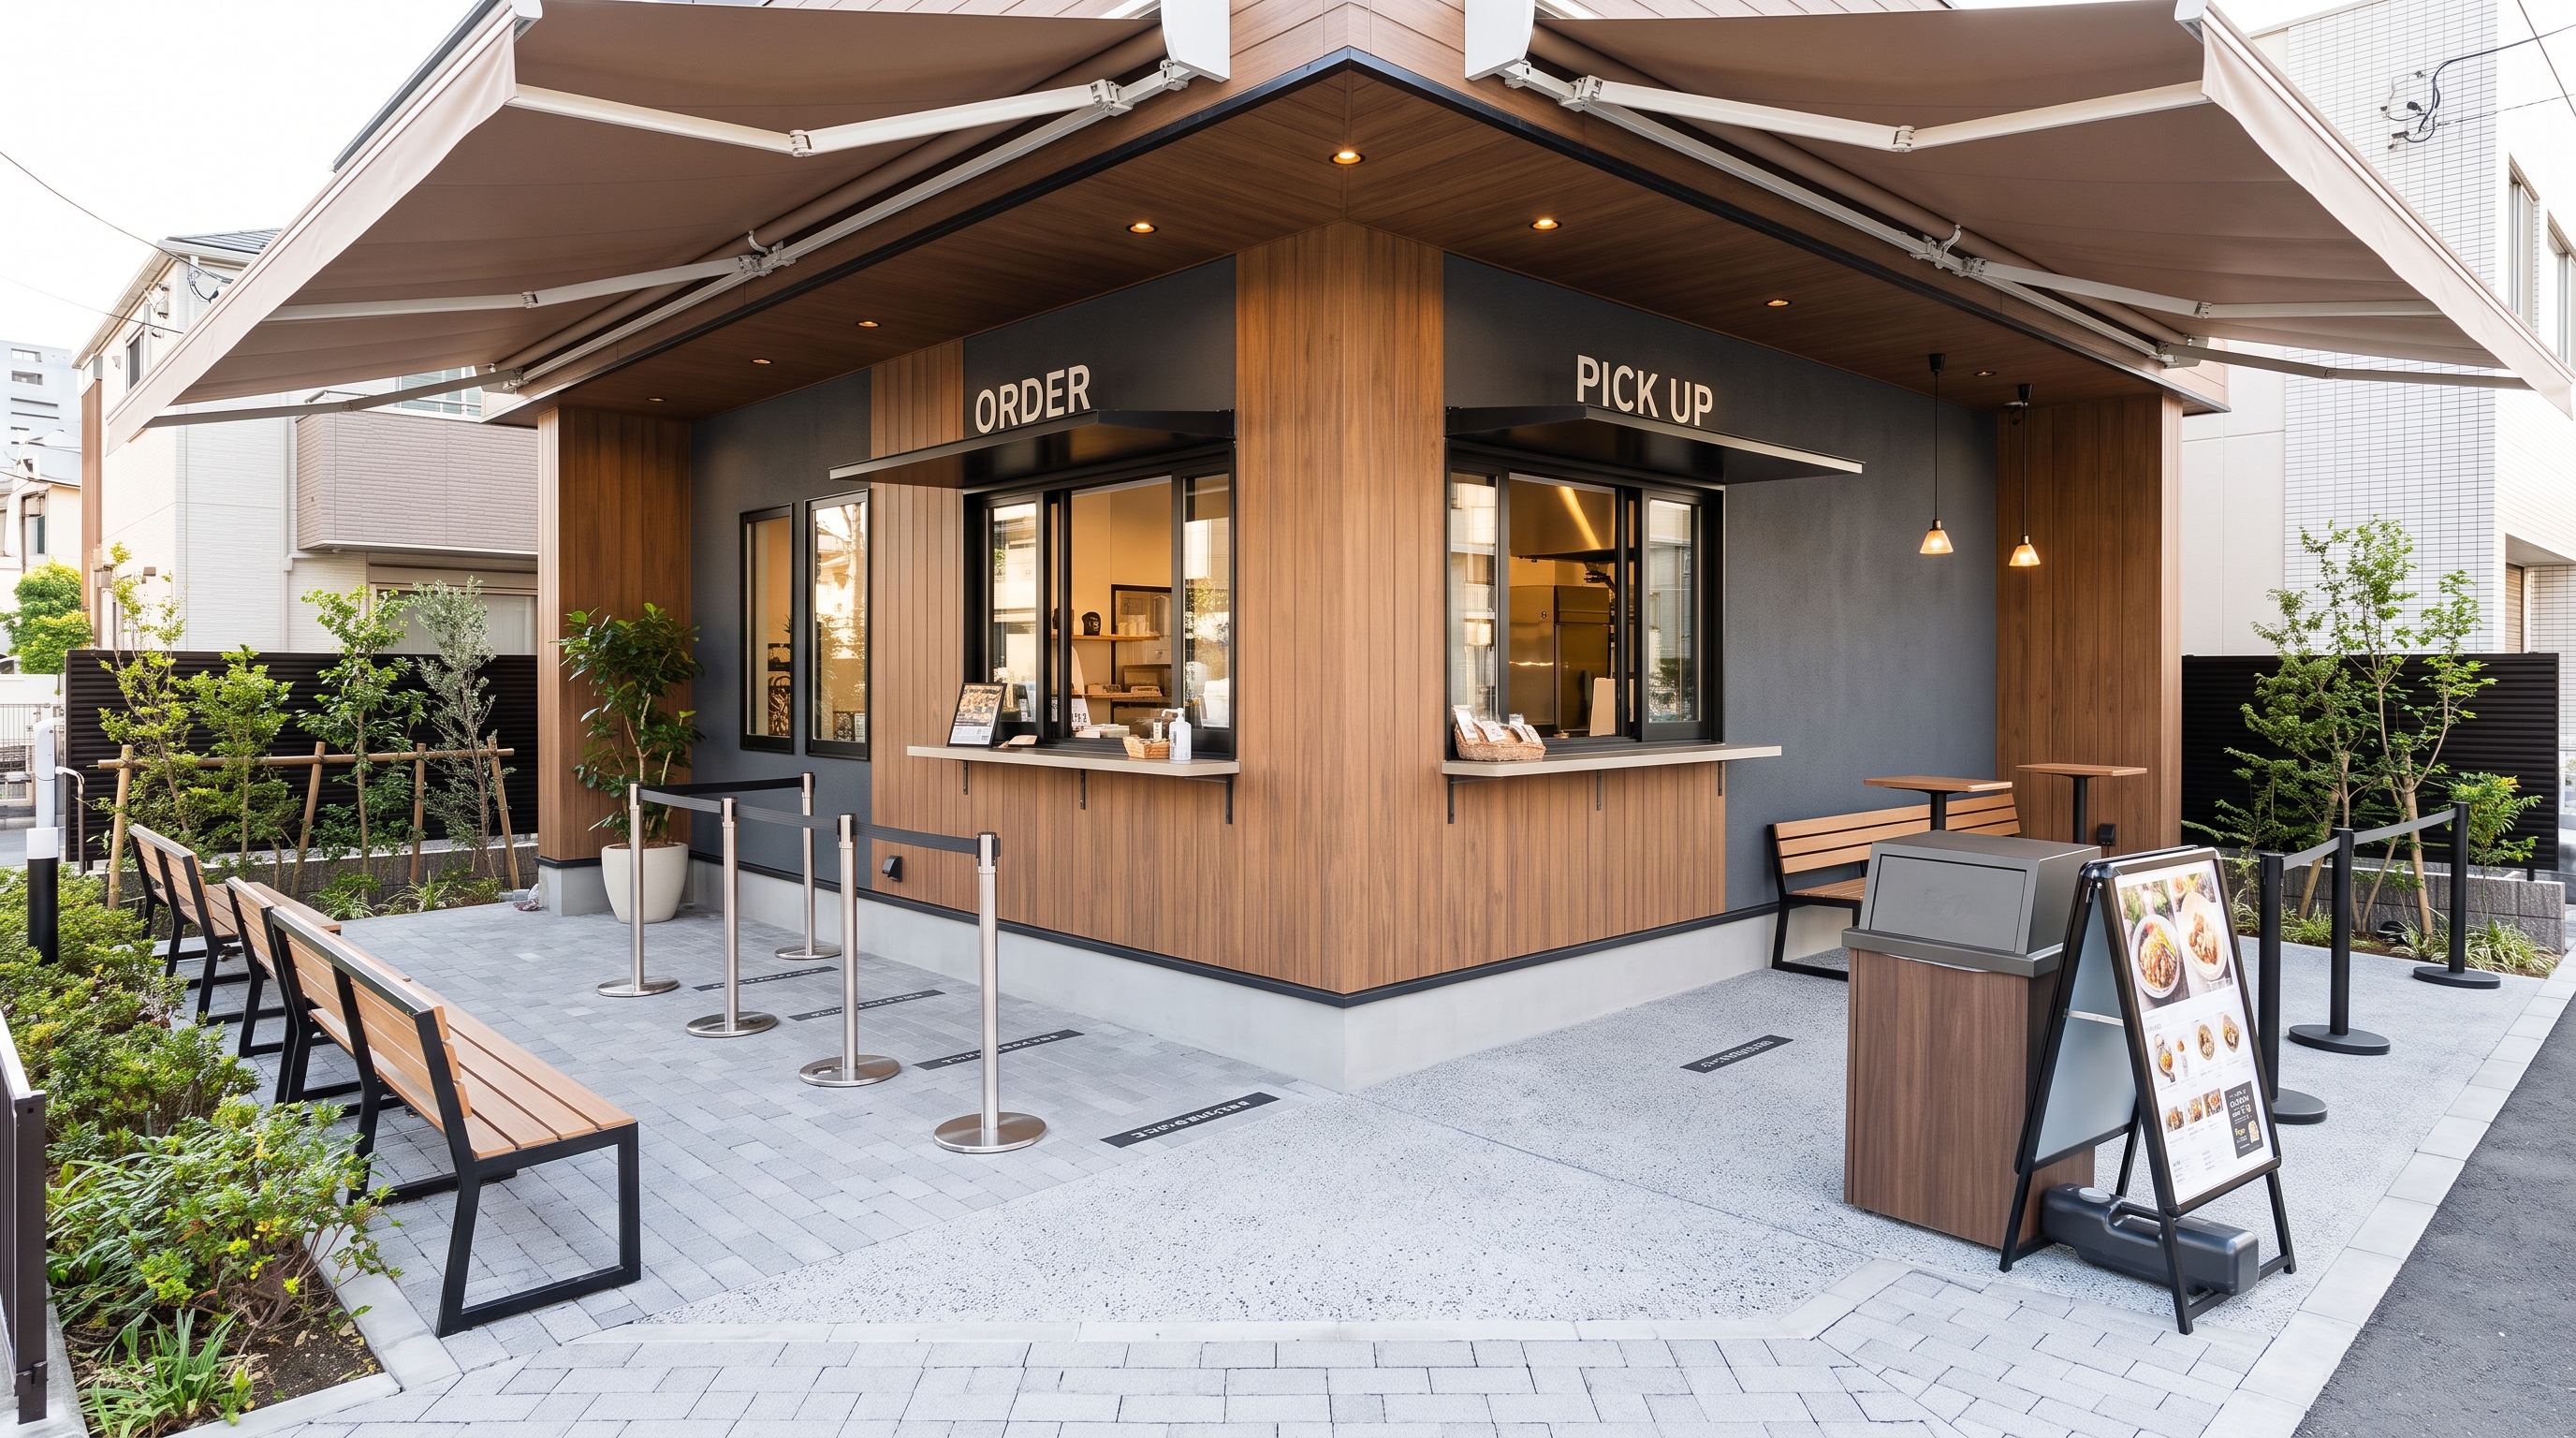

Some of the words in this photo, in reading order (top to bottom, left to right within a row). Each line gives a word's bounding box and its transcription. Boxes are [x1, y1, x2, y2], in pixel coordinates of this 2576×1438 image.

[974, 364, 1091, 434] ORDER
[1576, 354, 1660, 418] PICK
[1670, 377, 1714, 427] UP
